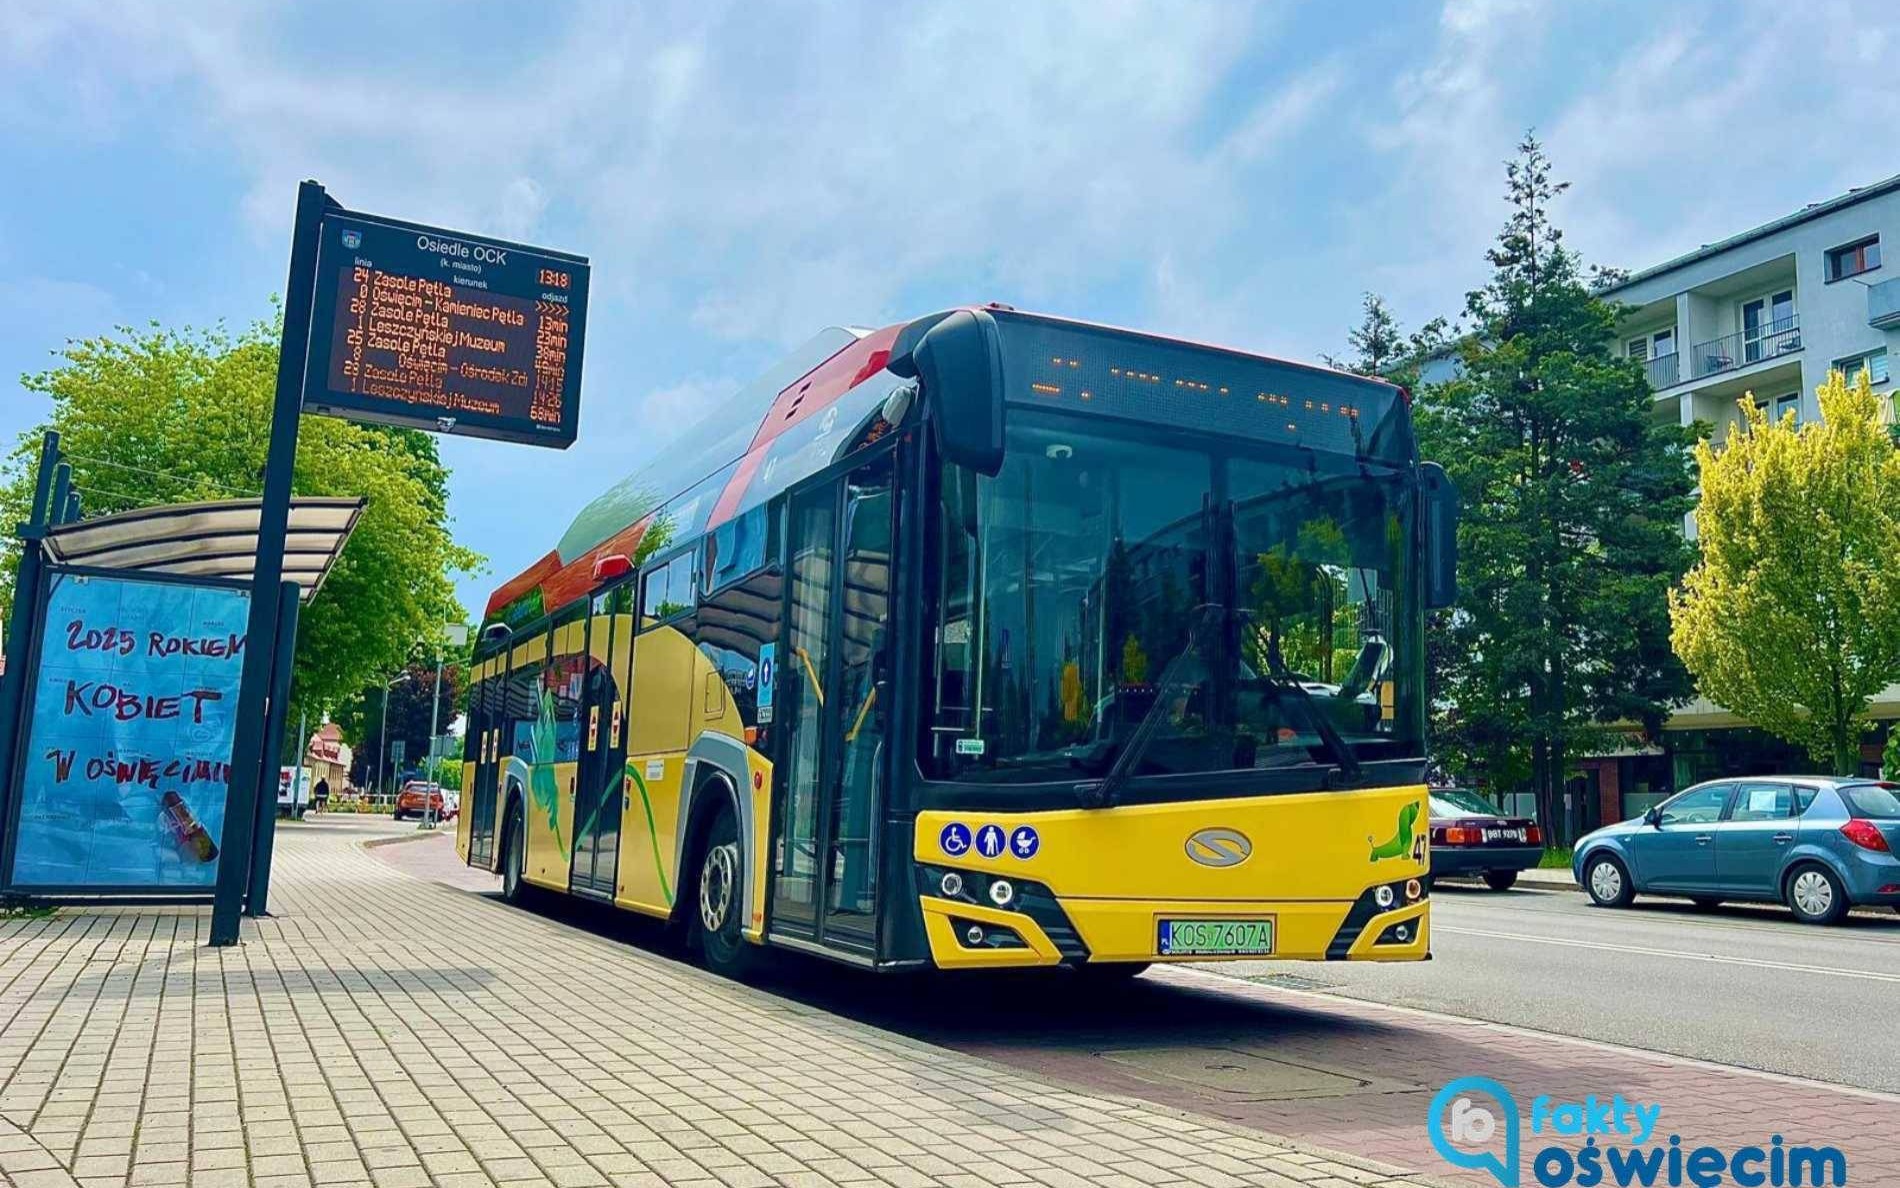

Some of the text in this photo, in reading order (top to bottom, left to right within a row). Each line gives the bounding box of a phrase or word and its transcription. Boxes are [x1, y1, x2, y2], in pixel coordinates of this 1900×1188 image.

[354, 256, 373, 268] linia
[417, 236, 507, 266] Osiedle OCK
[452, 260, 482, 274] miasto)
[354, 267, 452, 298] 24 Zasole Pętla
[453, 275, 488, 289] kierunek
[542, 292, 568, 304] odjazd
[350, 298, 366, 314] 28
[371, 301, 414, 322] Zasole
[536, 330, 567, 349] 23min
[434, 297, 491, 320] Kamieniec
[491, 306, 525, 326] Pętla
[540, 315, 568, 334] 13min
[347, 329, 363, 345] 25
[367, 332, 411, 353] Zasole
[459, 332, 506, 353] Muzeum
[66, 619, 136, 656] 2025
[65, 680, 222, 724] KOBIET
[46, 750, 76, 784] W
[1171, 924, 1269, 948] KOS 7607A
